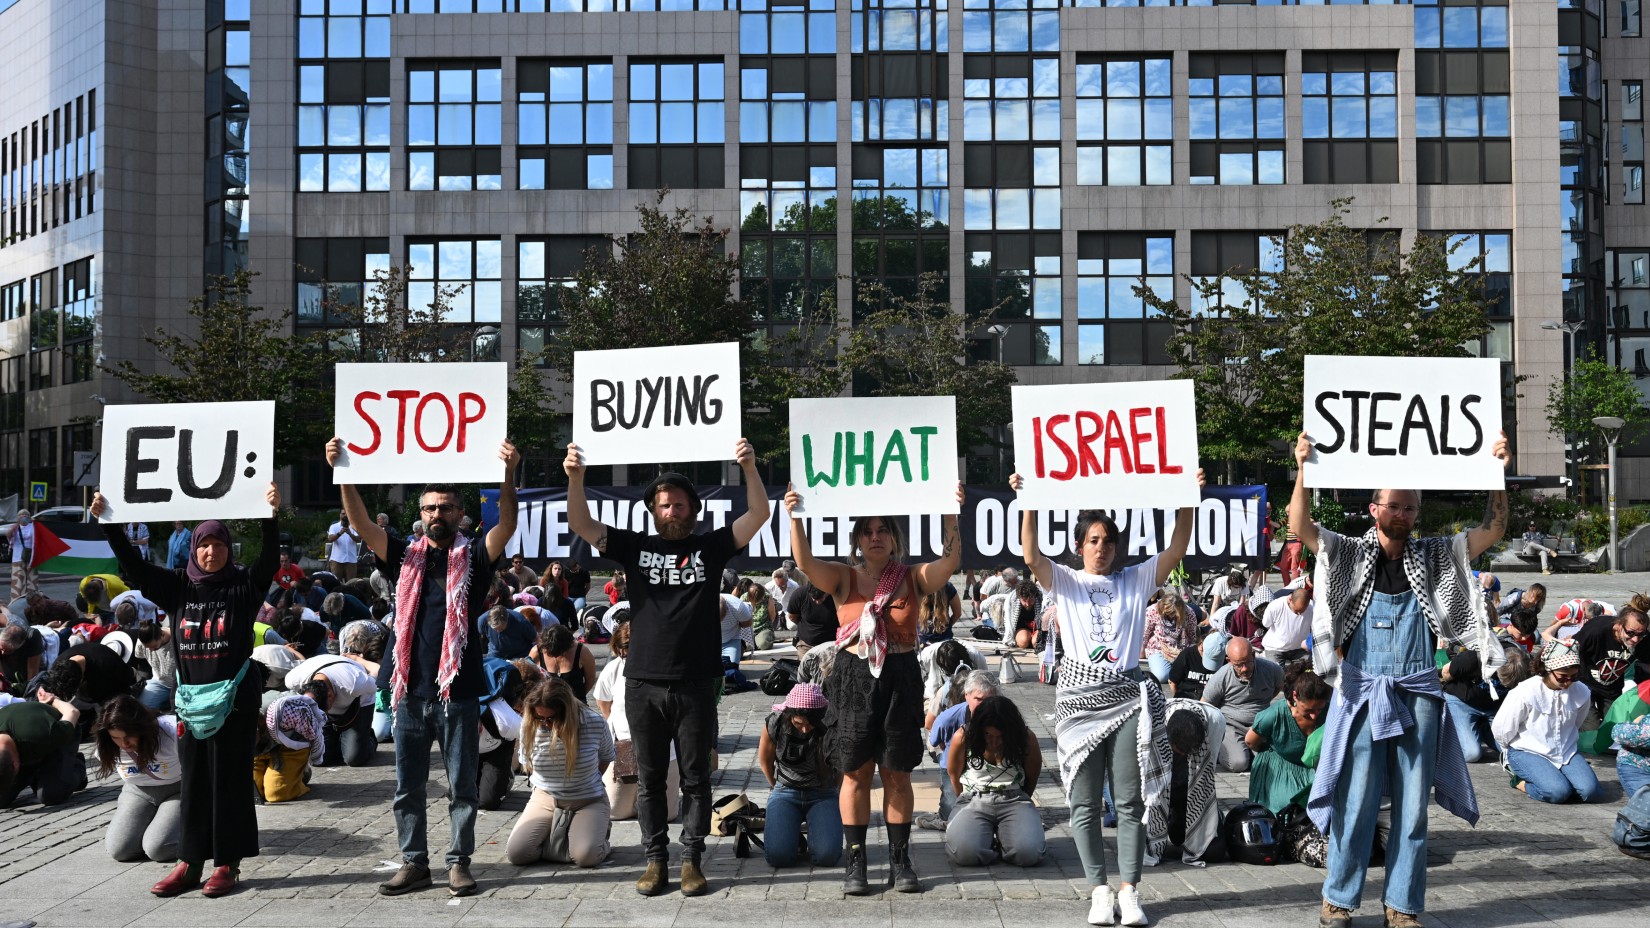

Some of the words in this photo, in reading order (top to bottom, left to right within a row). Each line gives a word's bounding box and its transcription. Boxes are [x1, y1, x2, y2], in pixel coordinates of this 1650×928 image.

[347, 390, 486, 455] STOP
[591, 374, 723, 432] BUYING
[1314, 390, 1483, 456] STEALS
[124, 426, 257, 503] EU:
[802, 426, 938, 488] WHAT
[1032, 407, 1183, 481] ISRAEL
[505, 501, 570, 558] WE
[207, 641, 228, 650] DOWN
